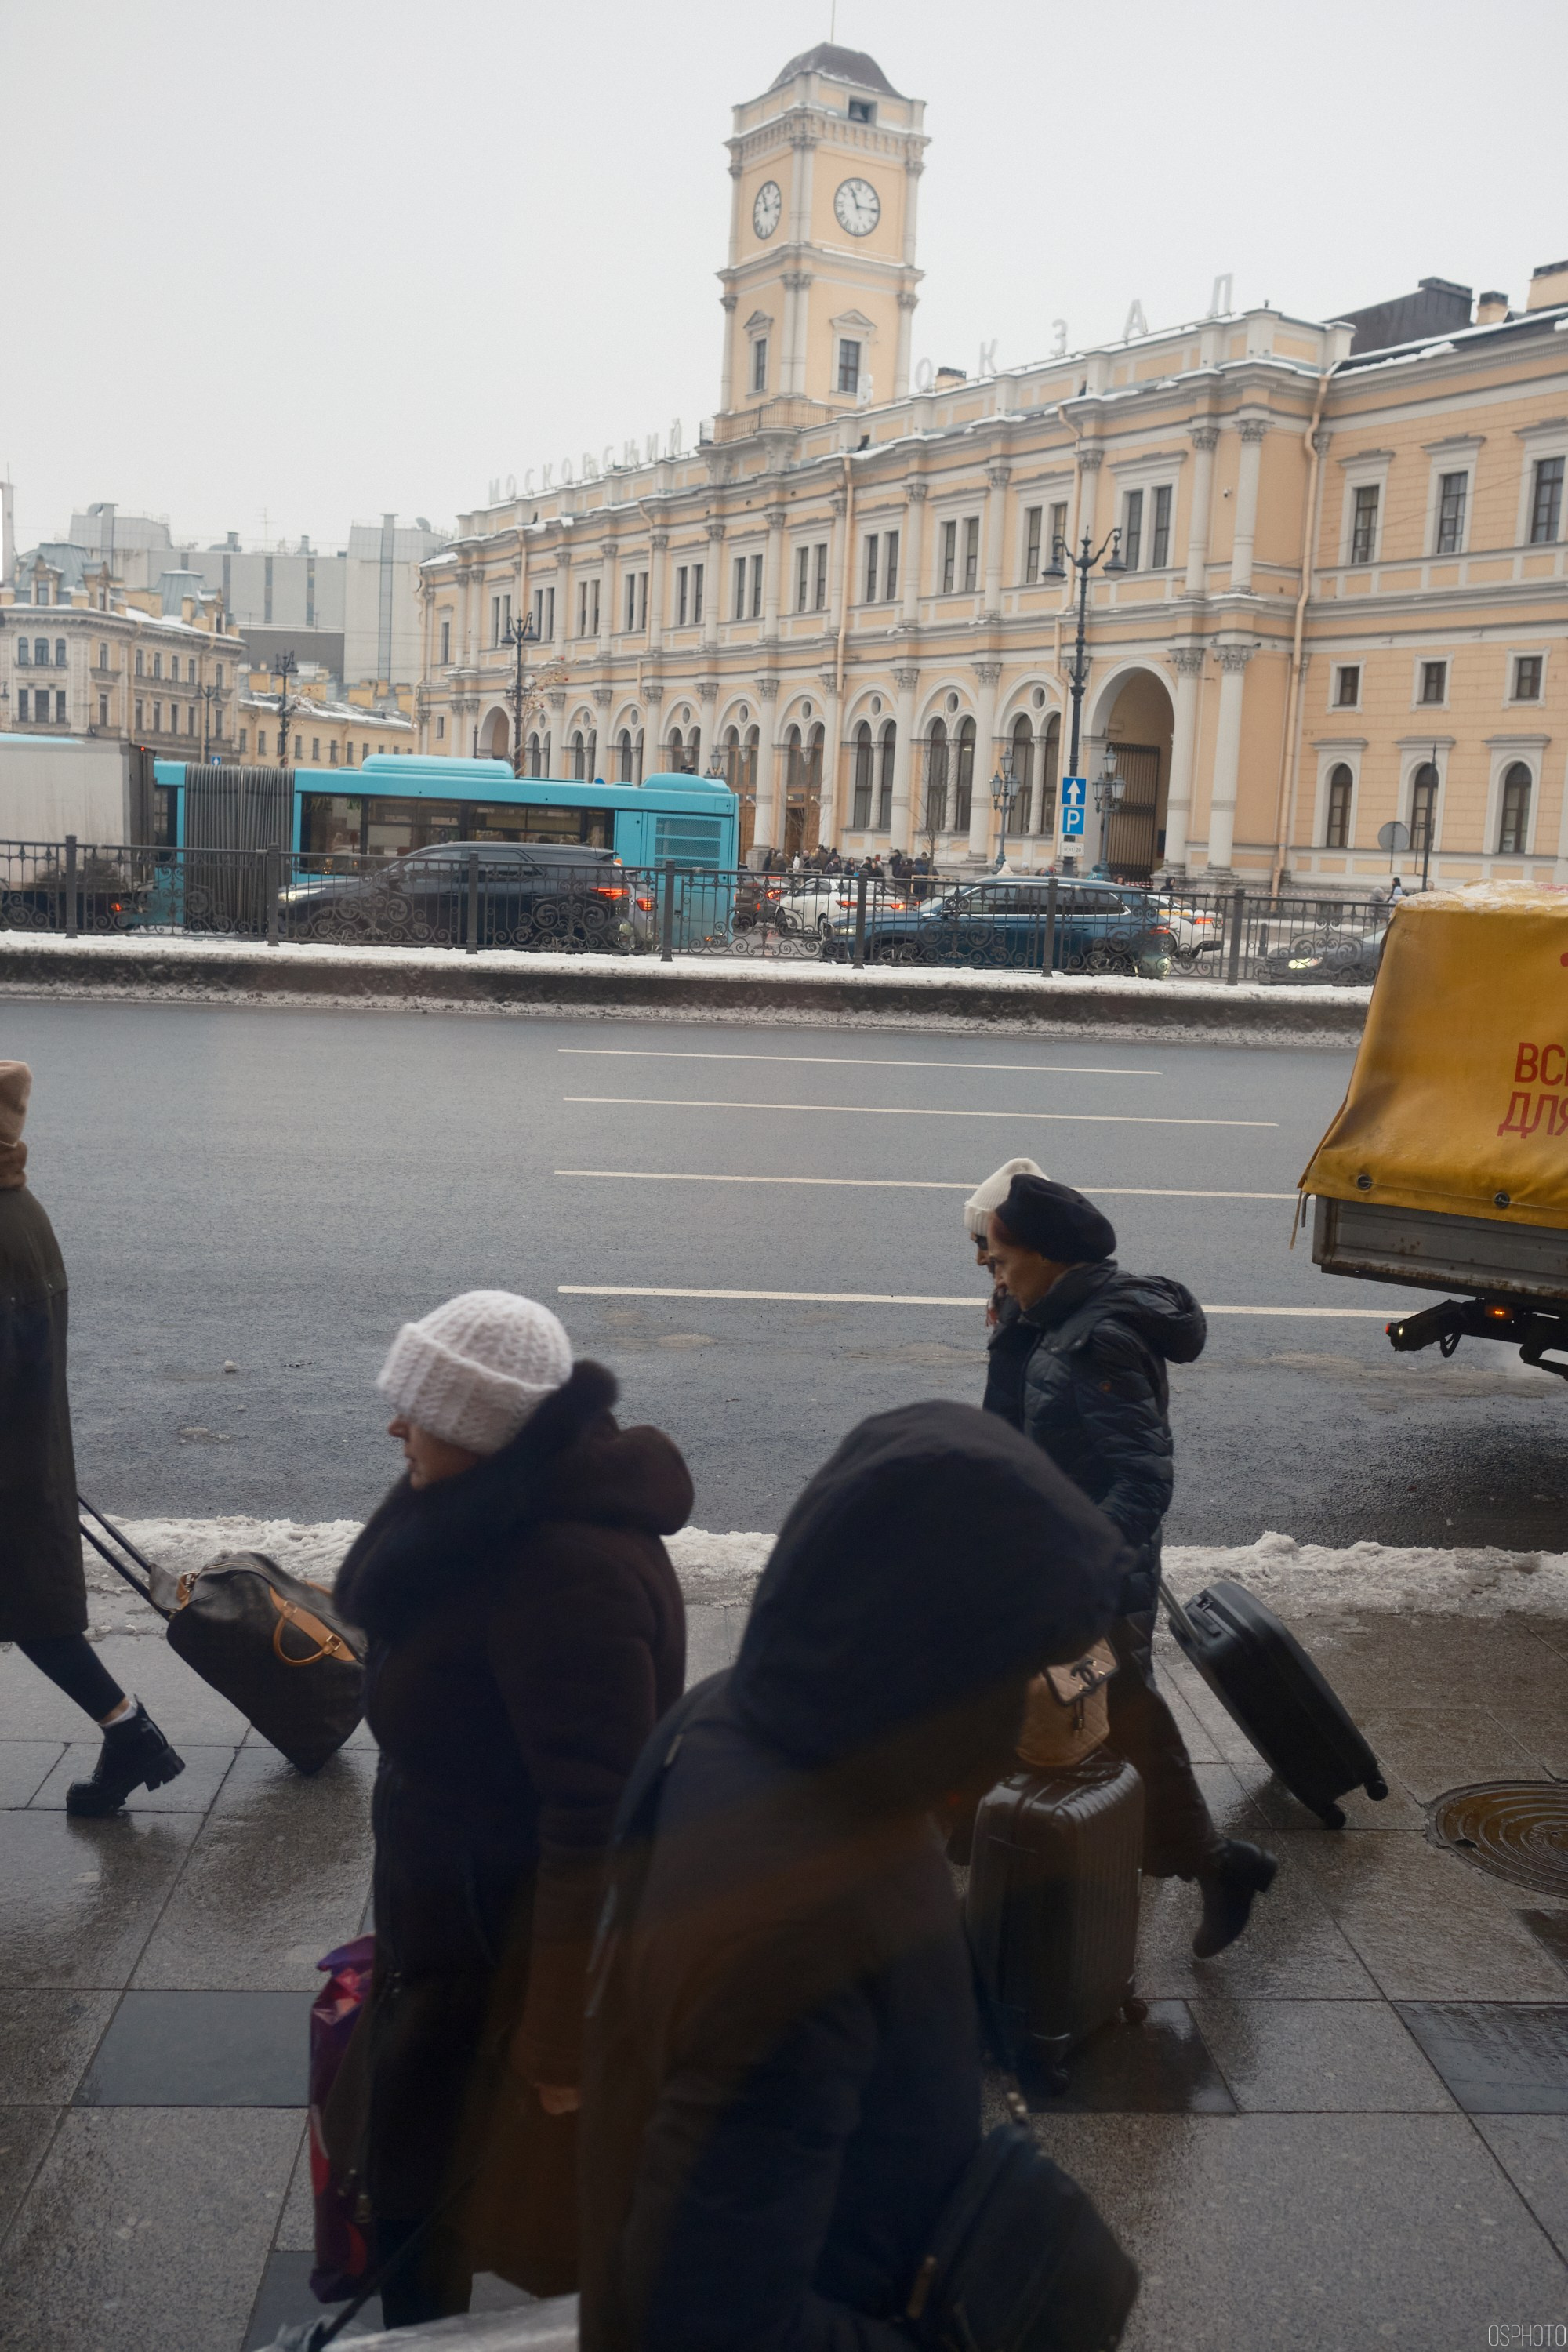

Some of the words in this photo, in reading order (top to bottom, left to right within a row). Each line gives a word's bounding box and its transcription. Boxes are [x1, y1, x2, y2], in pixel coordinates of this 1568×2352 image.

[857, 273, 1233, 406] ВОКЗАЛ
[1067, 809, 1080, 832] P
[1514, 1042, 1568, 1087] ВС
